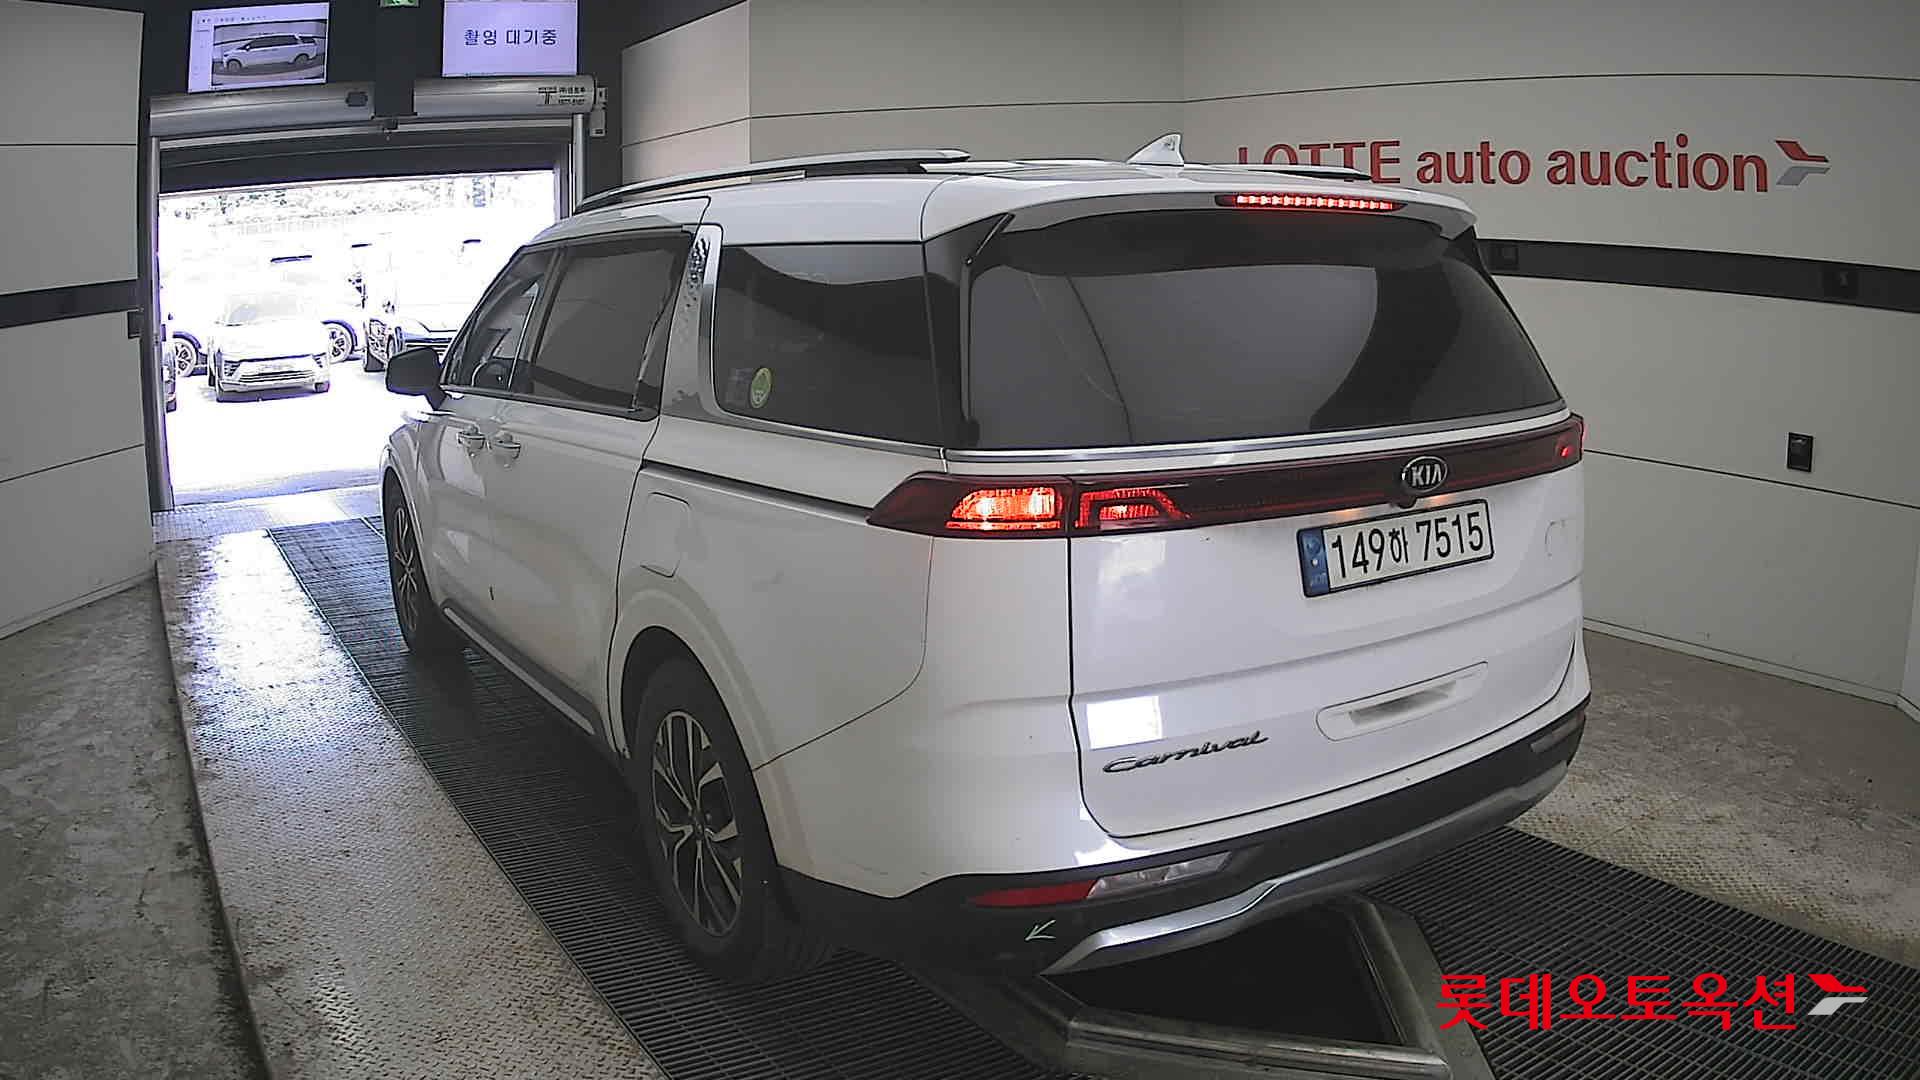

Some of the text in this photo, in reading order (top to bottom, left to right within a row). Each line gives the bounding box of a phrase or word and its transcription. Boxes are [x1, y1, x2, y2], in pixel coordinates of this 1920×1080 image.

[464, 28, 558, 46] 촬영 대기중
[1416, 141, 1531, 185] auto
[1546, 133, 1769, 193] auction
[1411, 463, 1443, 488] KIA
[1331, 511, 1484, 579] 149하 7515
[1102, 730, 1269, 773] Carnival
